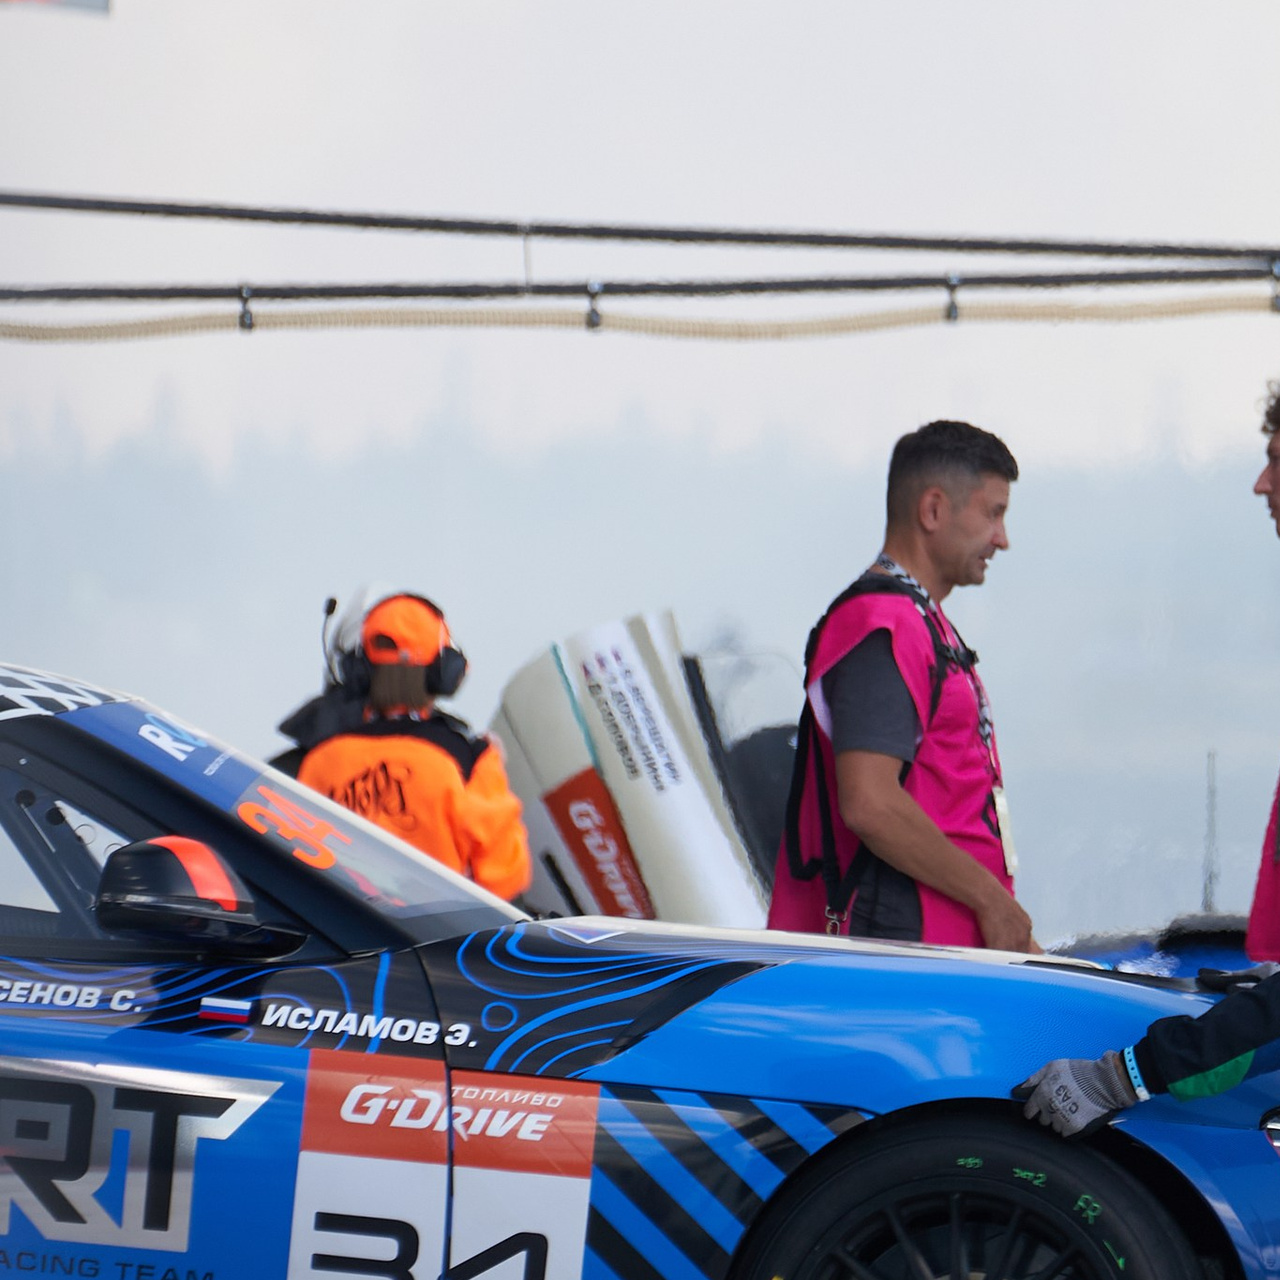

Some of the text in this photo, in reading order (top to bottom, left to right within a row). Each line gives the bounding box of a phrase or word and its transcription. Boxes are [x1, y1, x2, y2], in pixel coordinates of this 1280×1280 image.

[237, 785, 352, 870] 34
[109, 989, 143, 1013] С.
[261, 1004, 478, 1048] ИСЛАМОВ Э.
[451, 1086, 563, 1108] ТОПЛИВО
